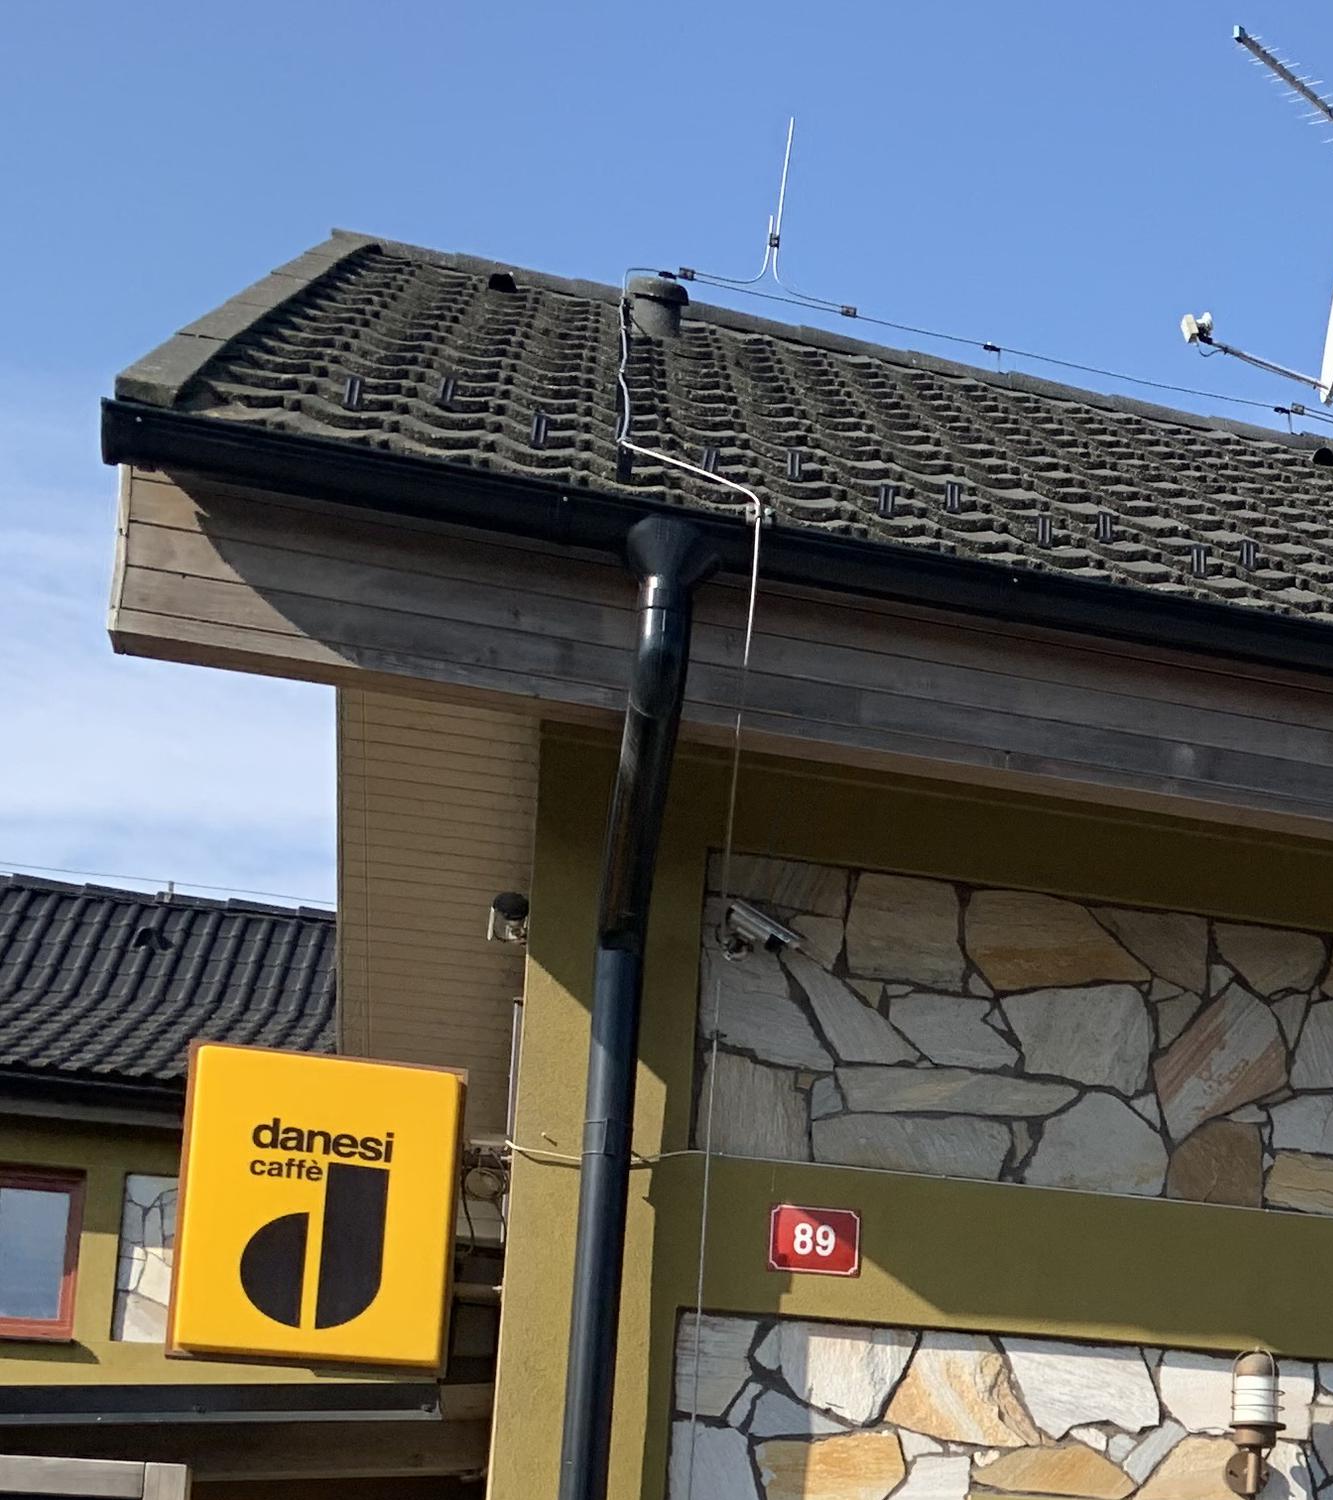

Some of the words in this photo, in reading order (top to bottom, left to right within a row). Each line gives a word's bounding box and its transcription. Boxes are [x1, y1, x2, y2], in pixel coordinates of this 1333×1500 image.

[252, 1117, 395, 1163] danesi
[249, 1158, 324, 1182] caffè
[793, 1222, 836, 1257] 89
